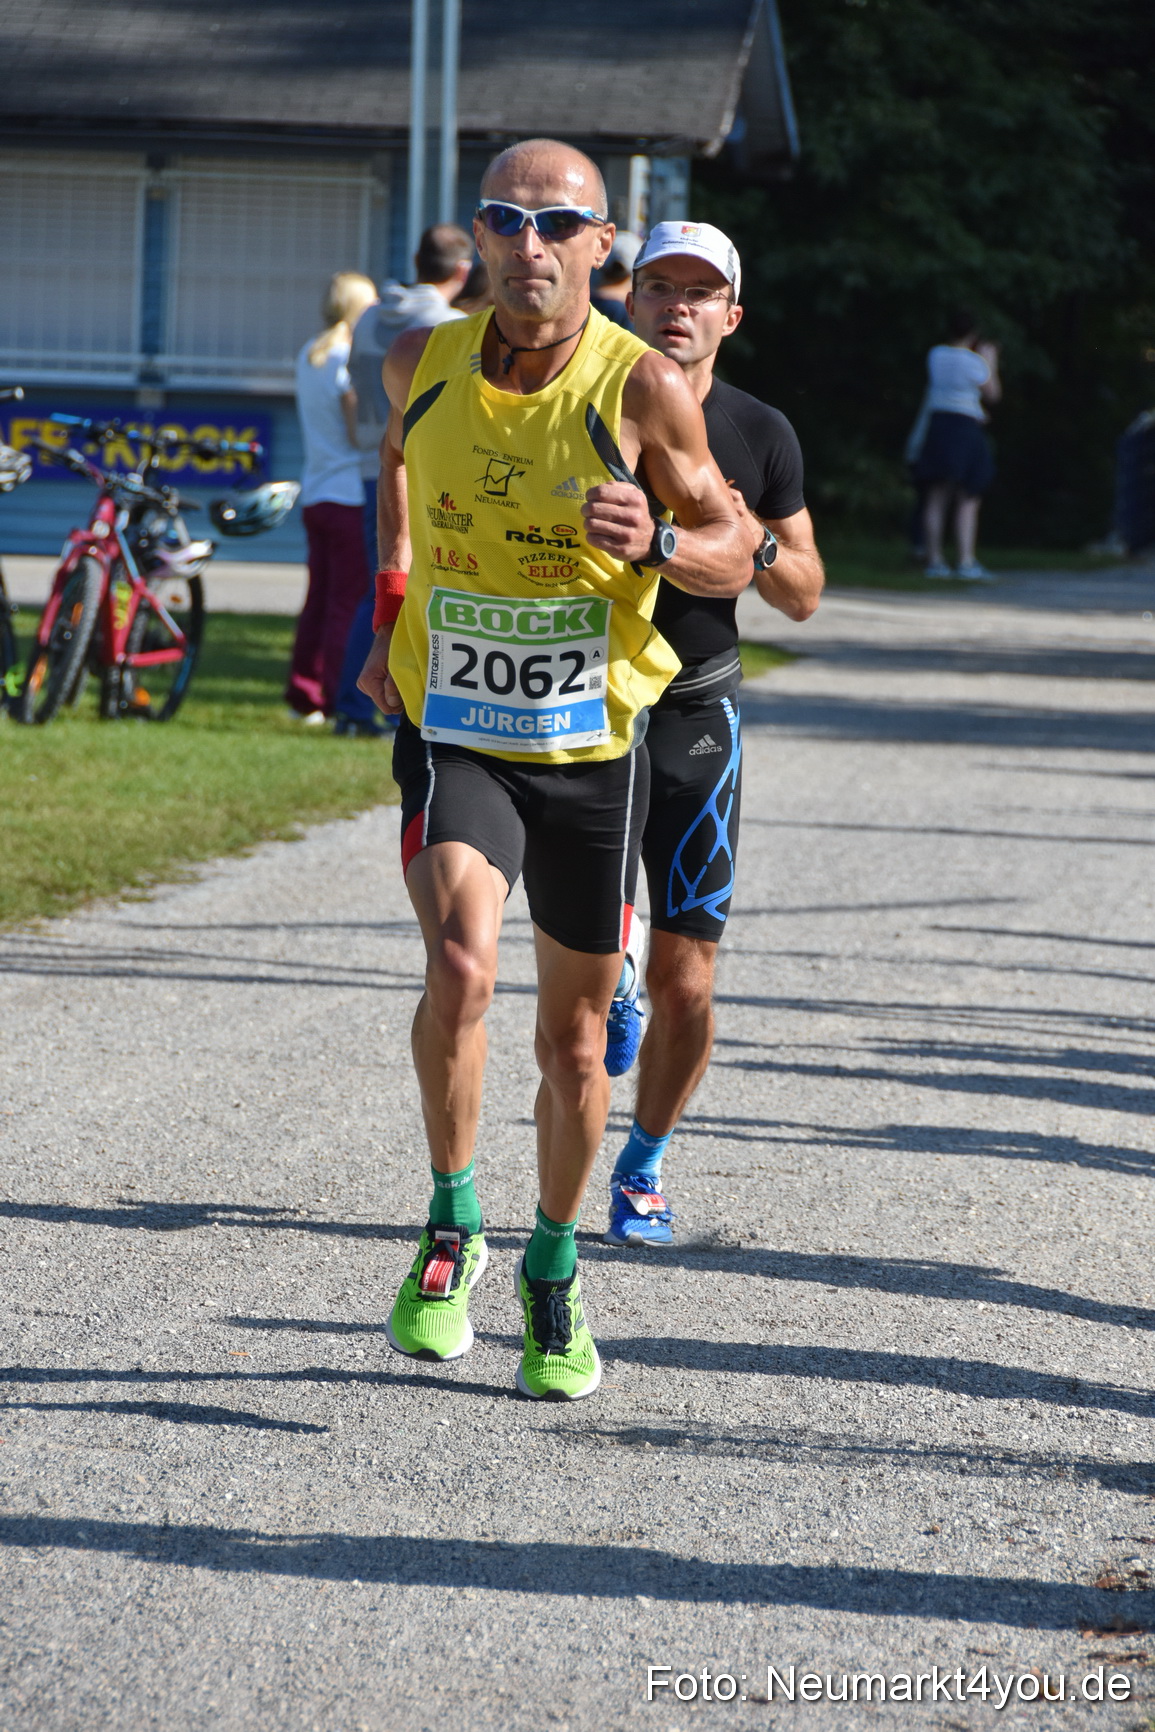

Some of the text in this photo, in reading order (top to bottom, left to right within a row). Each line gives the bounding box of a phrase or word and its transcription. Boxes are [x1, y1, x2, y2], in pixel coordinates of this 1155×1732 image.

[472, 444, 534, 466] FONDS ENTRUM
[474, 494, 520, 510] NEUMARKT
[552, 489, 585, 500] adidas
[555, 526, 575, 534] Esso
[448, 550, 460, 568] &
[467, 552, 478, 570] S
[518, 552, 580, 568] PIZZERIA
[528, 564, 573, 578] ELIO
[442, 599, 592, 638] BOCK
[450, 643, 586, 700] 2062
[461, 706, 571, 734] JÜRGEN
[689, 746, 723, 755] adidas
